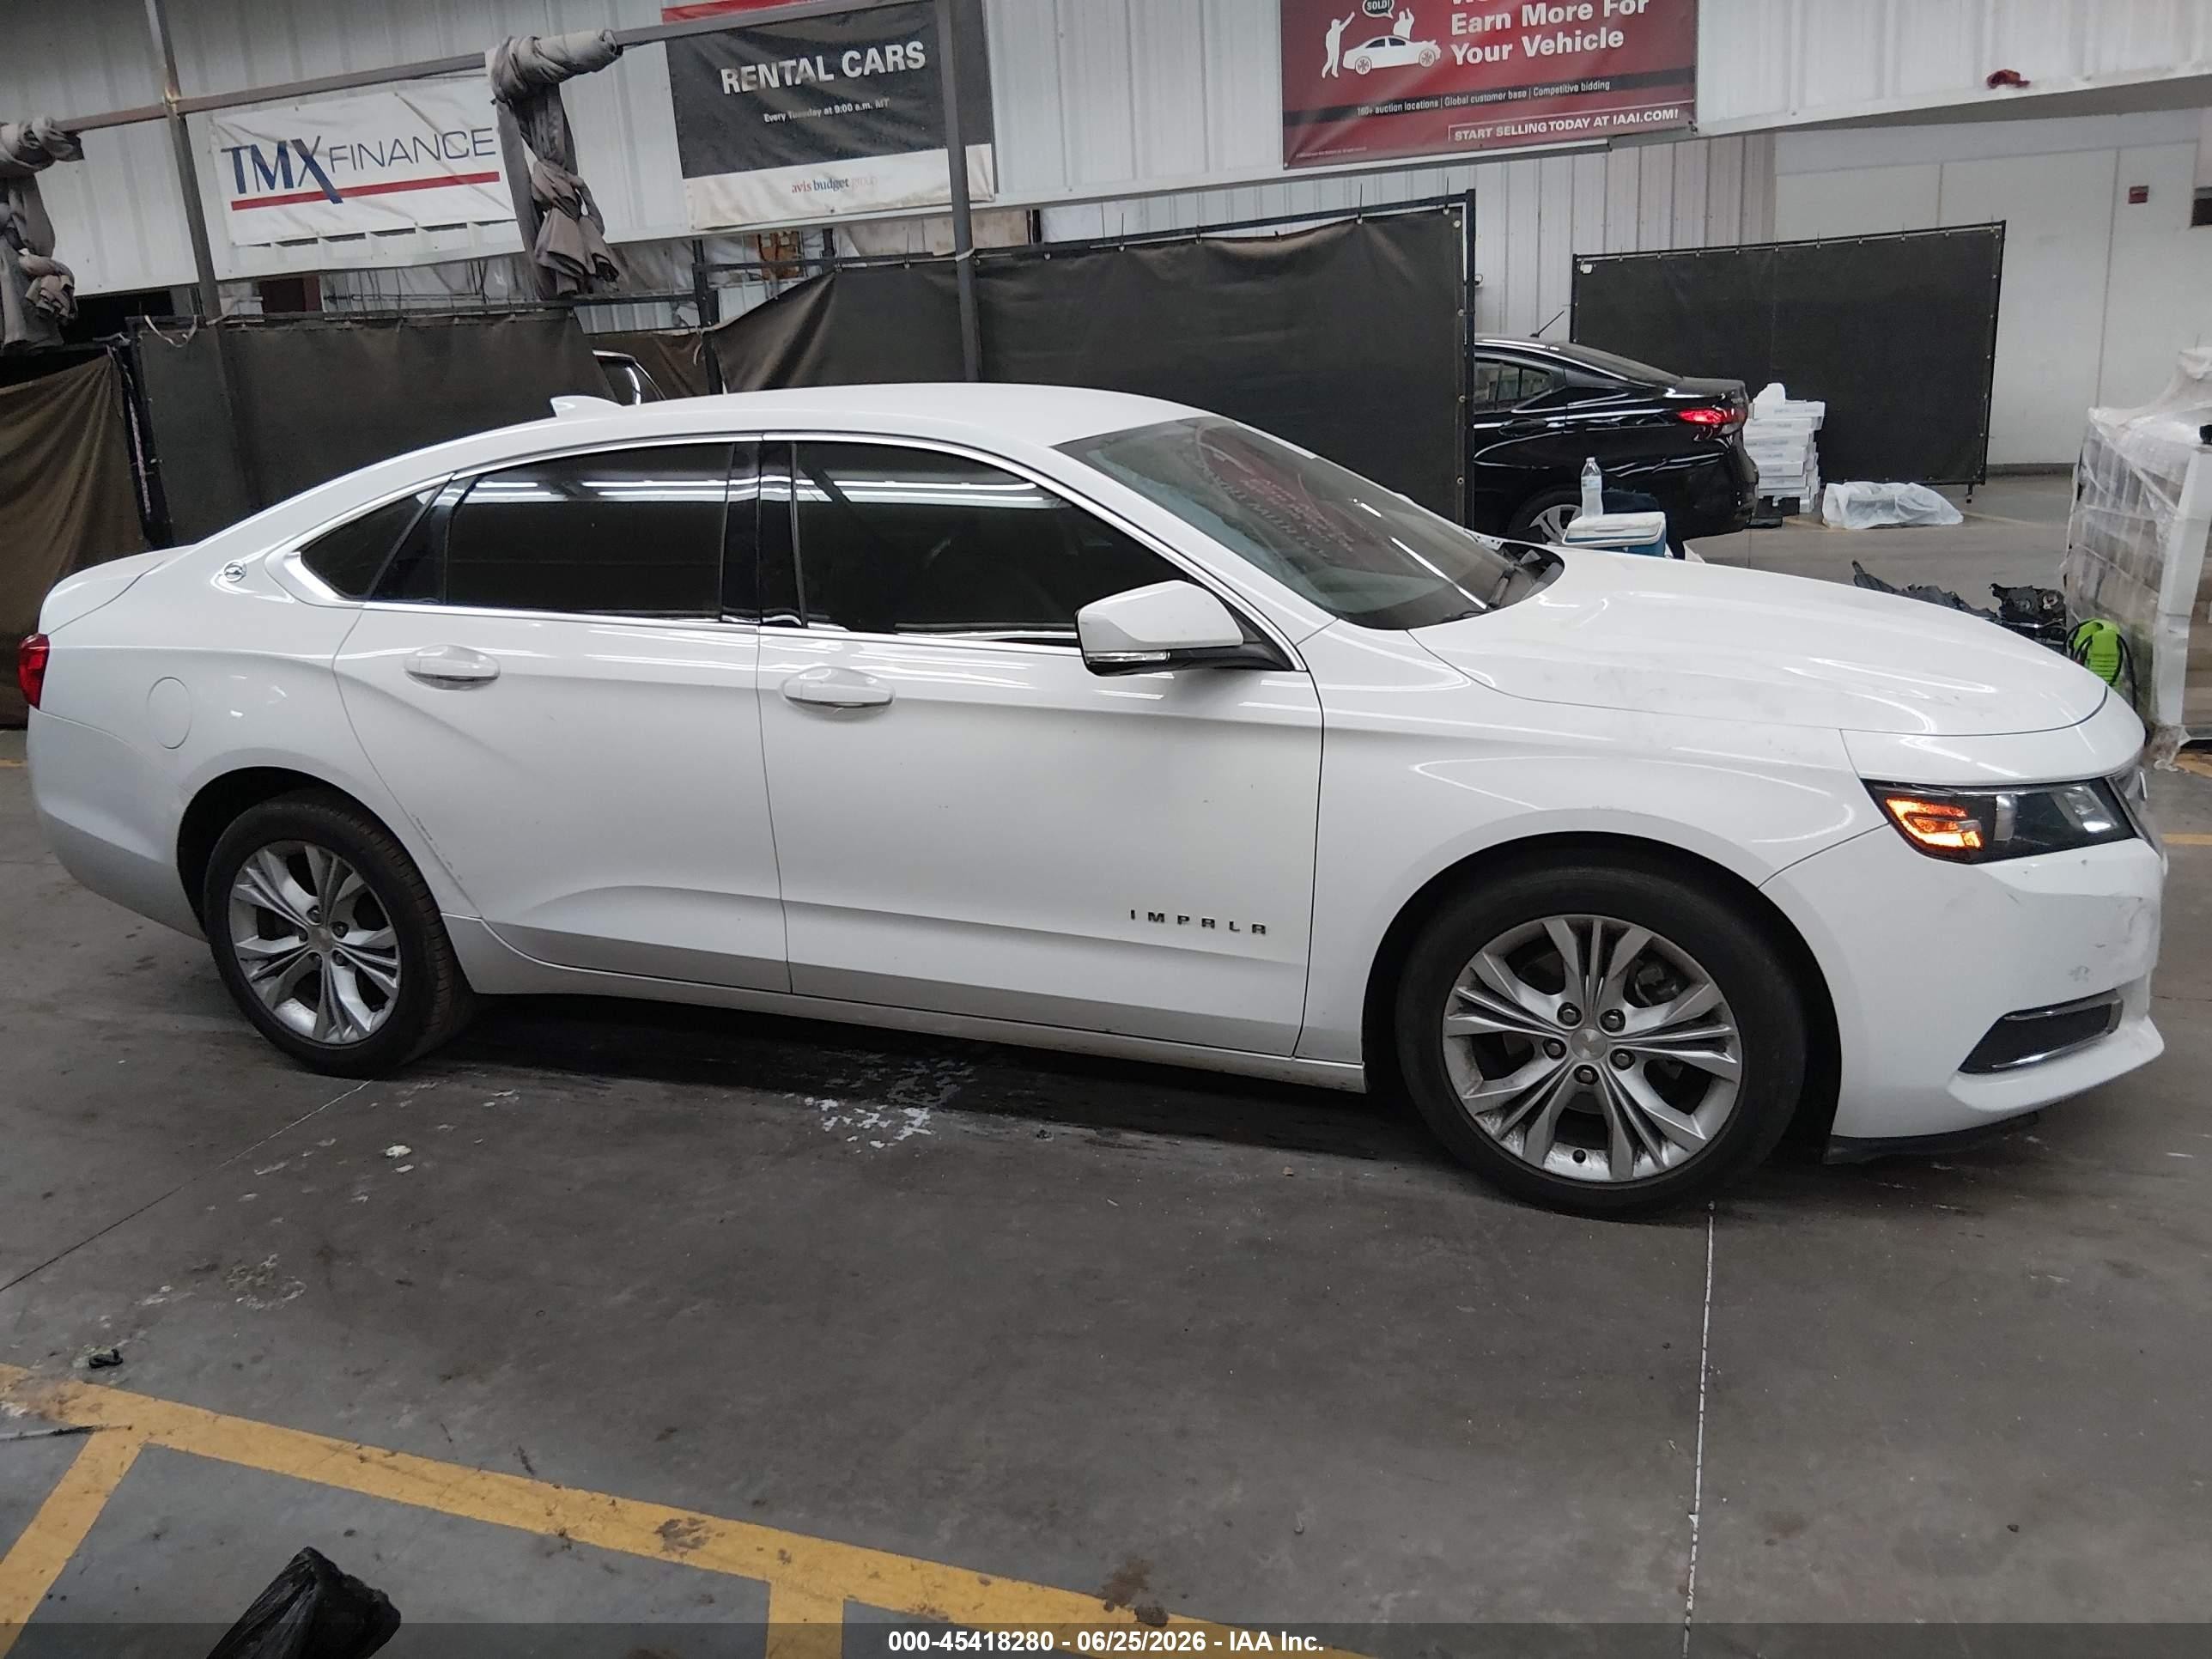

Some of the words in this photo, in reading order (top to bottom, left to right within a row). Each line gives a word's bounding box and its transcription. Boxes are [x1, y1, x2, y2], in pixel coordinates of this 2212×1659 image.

[1451, 12, 1511, 36] Earn
[1522, 3, 1594, 27] More
[1603, 0, 1650, 17] For
[1449, 42, 1513, 66] Your
[1522, 27, 1625, 58] Vehicle
[721, 55, 835, 94] RENTAL
[842, 40, 926, 79] CARS
[763, 112, 787, 123] Every
[823, 106, 833, 115] at
[834, 102, 854, 113] 9:00
[1375, 102, 1402, 115] auction
[1404, 99, 1438, 112] locations
[1444, 94, 1469, 106] Global
[1470, 91, 1506, 104] customer
[1508, 89, 1527, 100] base
[1533, 83, 1579, 98] Competitive
[1581, 81, 1611, 92] bidding
[1455, 127, 1492, 142] START
[1496, 122, 1547, 137] SELLING
[1549, 118, 1590, 131] TODAY
[1593, 115, 1610, 128] AT
[1613, 108, 1679, 125] IAAI.COM!
[221, 136, 343, 204] TMX
[330, 128, 496, 173] FINANCE
[792, 180, 812, 193] avis
[813, 178, 849, 191] budget
[1130, 909, 1267, 935] IMPALA
